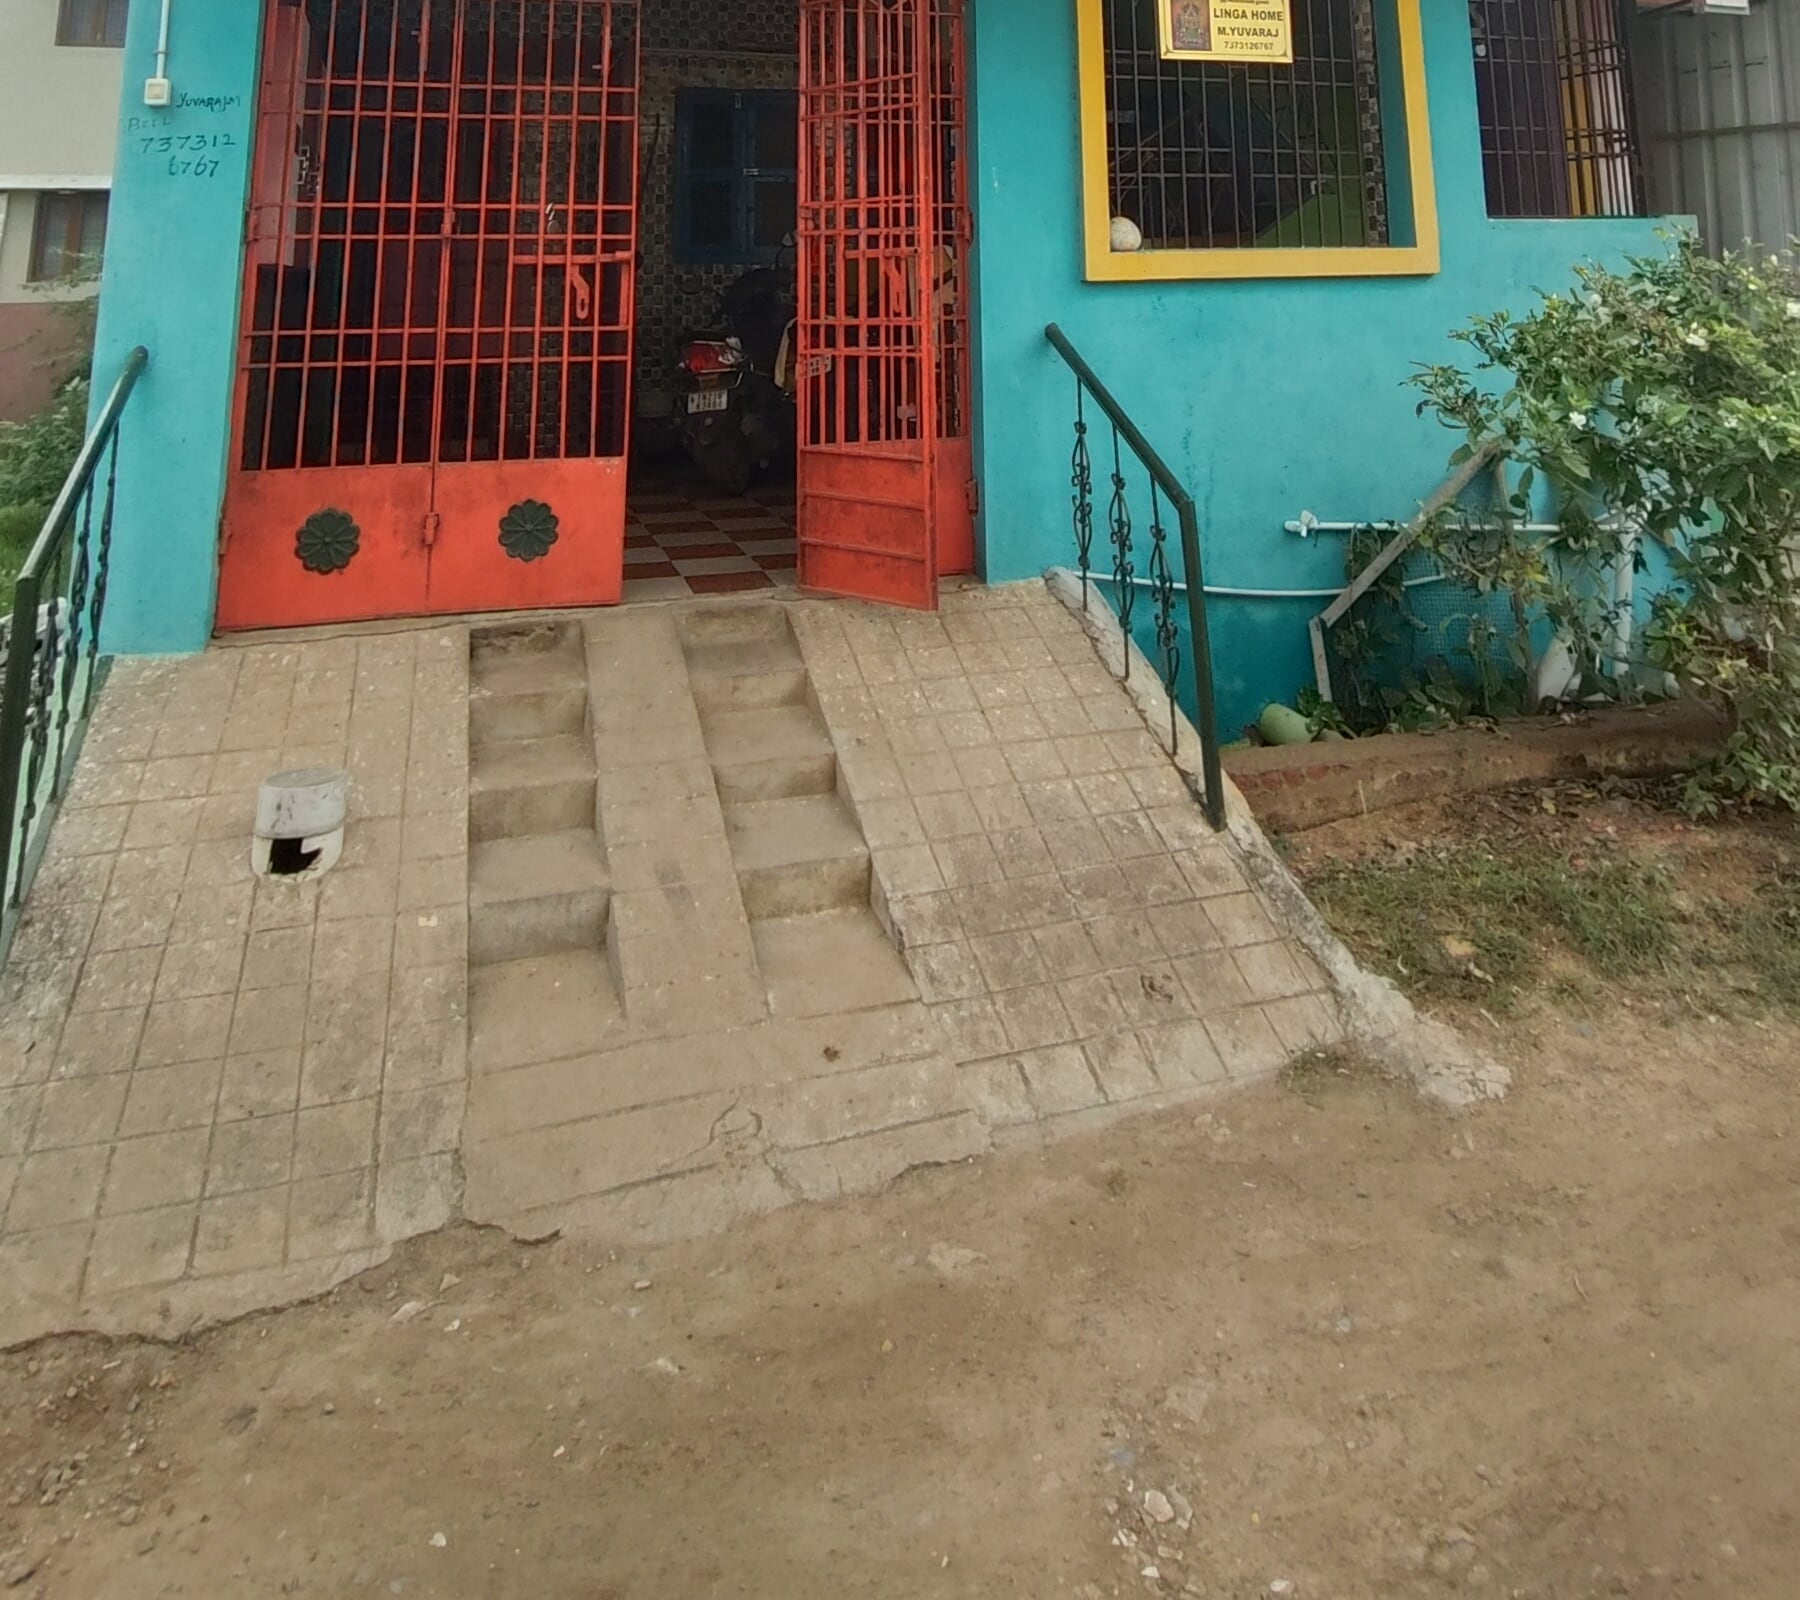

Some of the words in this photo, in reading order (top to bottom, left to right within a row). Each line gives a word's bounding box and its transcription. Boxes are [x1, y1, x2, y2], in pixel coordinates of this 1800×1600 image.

[1213, 8, 1248, 19] LINGA
[1251, 10, 1283, 21] HOME
[1217, 26, 1279, 38] M.YUVARAJ
[1224, 41, 1273, 50] 7373126767
[140, 133, 236, 154] 737312
[168, 155, 220, 178] 6767
